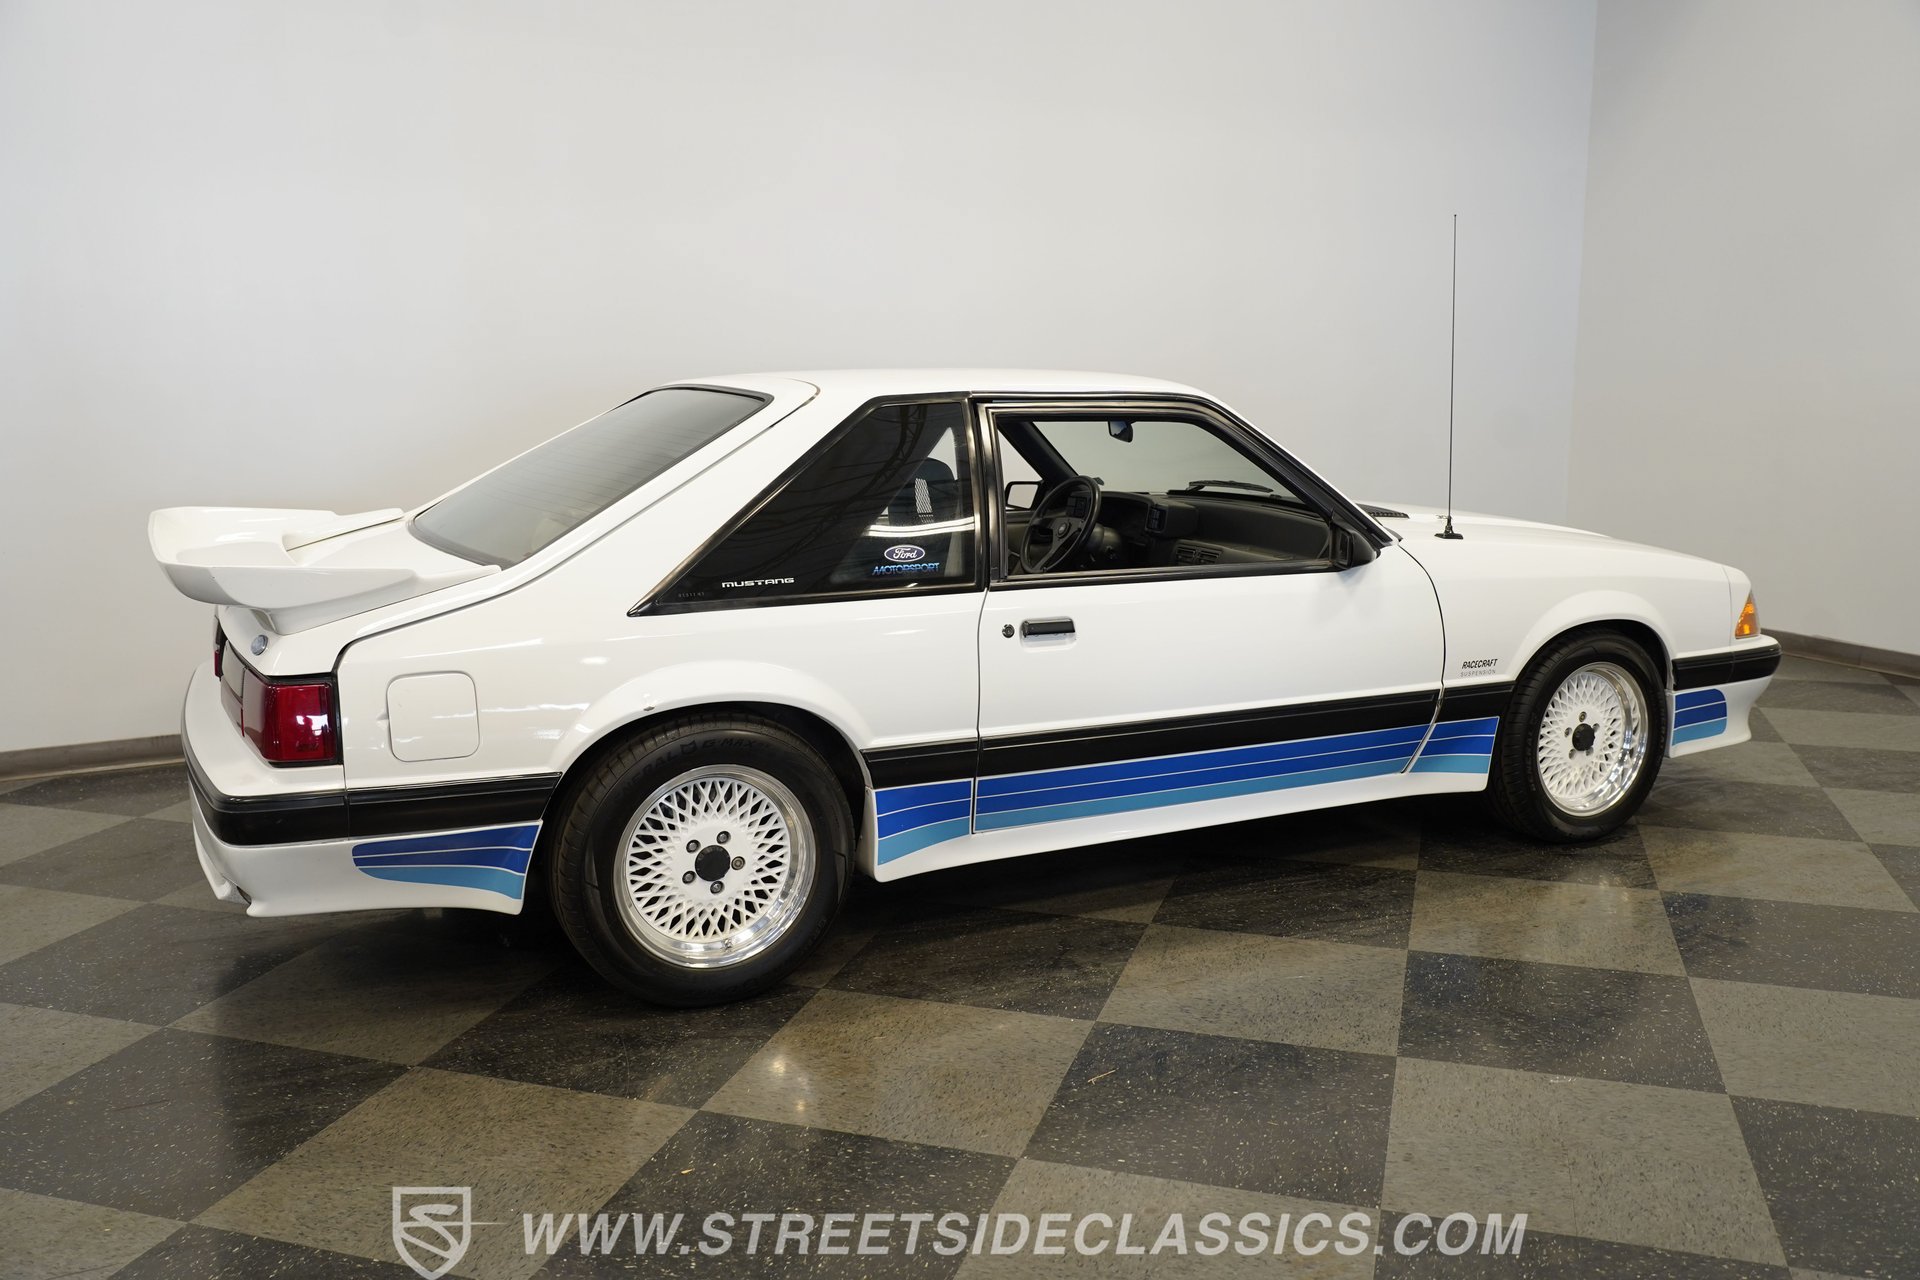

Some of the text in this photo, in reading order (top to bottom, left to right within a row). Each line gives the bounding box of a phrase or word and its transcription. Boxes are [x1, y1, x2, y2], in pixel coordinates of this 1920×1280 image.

[893, 547, 918, 560] Ford
[872, 563, 940, 576] MOTORSPORT
[722, 577, 795, 588] MUSTANG
[1461, 658, 1498, 670] RACECRAFT
[1460, 669, 1496, 677] SUSPENSION
